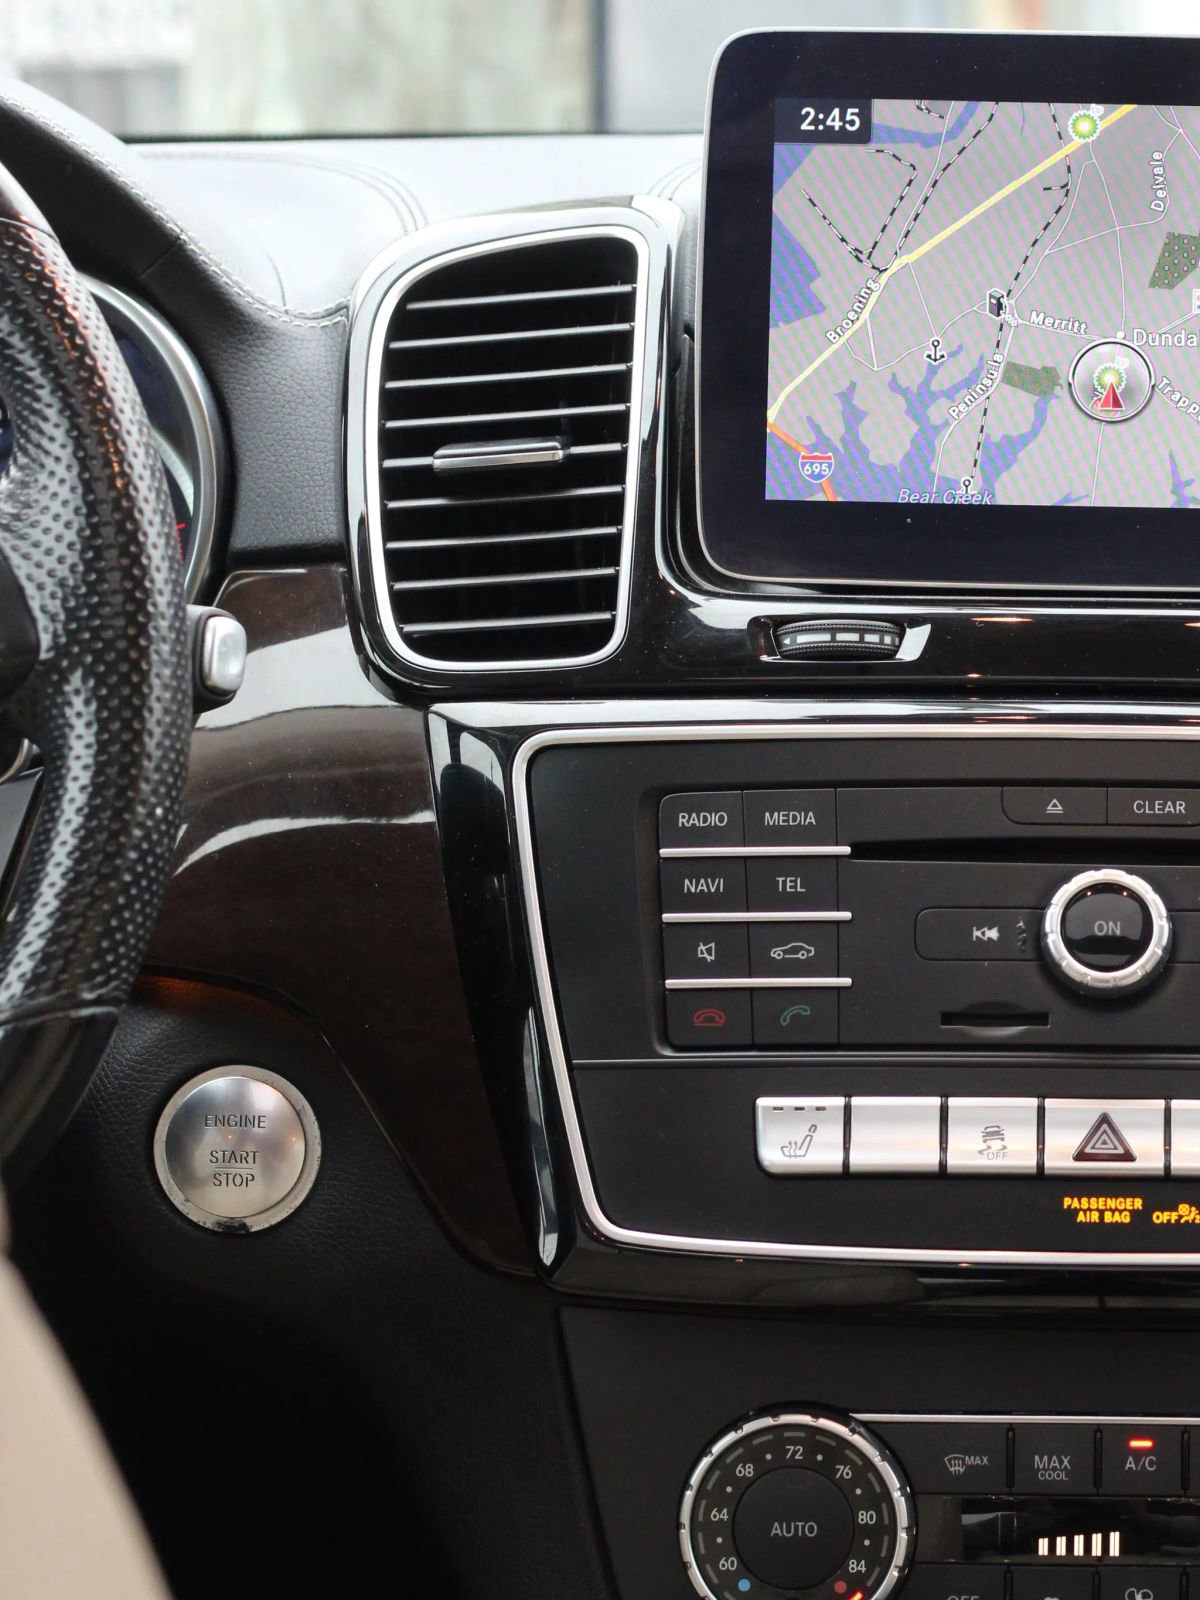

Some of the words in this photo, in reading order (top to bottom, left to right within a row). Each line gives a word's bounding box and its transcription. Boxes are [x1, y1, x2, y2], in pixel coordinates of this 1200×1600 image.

[799, 107, 861, 131] 2:45
[1150, 151, 1165, 212] Delvale
[825, 278, 881, 344] Broening
[1029, 310, 1088, 336] Merritt
[947, 353, 1005, 420] Peninsula
[803, 463, 830, 475] 695
[898, 488, 938, 504] Bear
[1133, 800, 1186, 815] CLEAR
[678, 811, 728, 827] RADIO
[764, 811, 817, 826] MEDIA
[684, 878, 724, 894] NAVI
[775, 877, 806, 892] TEL
[1094, 920, 1121, 937] ON
[204, 1114, 267, 1129] ENGINE
[209, 1150, 260, 1165] START
[987, 1151, 1008, 1161] OFF
[212, 1172, 255, 1188] STOP
[1063, 1197, 1143, 1210] PASSENGER
[1076, 1211, 1100, 1223] AIR
[1104, 1211, 1131, 1223] BAG
[1152, 1211, 1179, 1224] OFF
[785, 1446, 804, 1460] 72
[965, 1456, 989, 1466] MAX
[1034, 1455, 1072, 1470] MAX
[1125, 1455, 1157, 1472] A/C
[735, 1463, 754, 1478] 68
[835, 1464, 852, 1480] 76
[1038, 1471, 1069, 1481] COOL
[710, 1508, 729, 1522] 64
[858, 1511, 877, 1525] 80
[770, 1521, 818, 1537] AUTO
[719, 1557, 738, 1571] 60
[848, 1560, 867, 1574] 84
